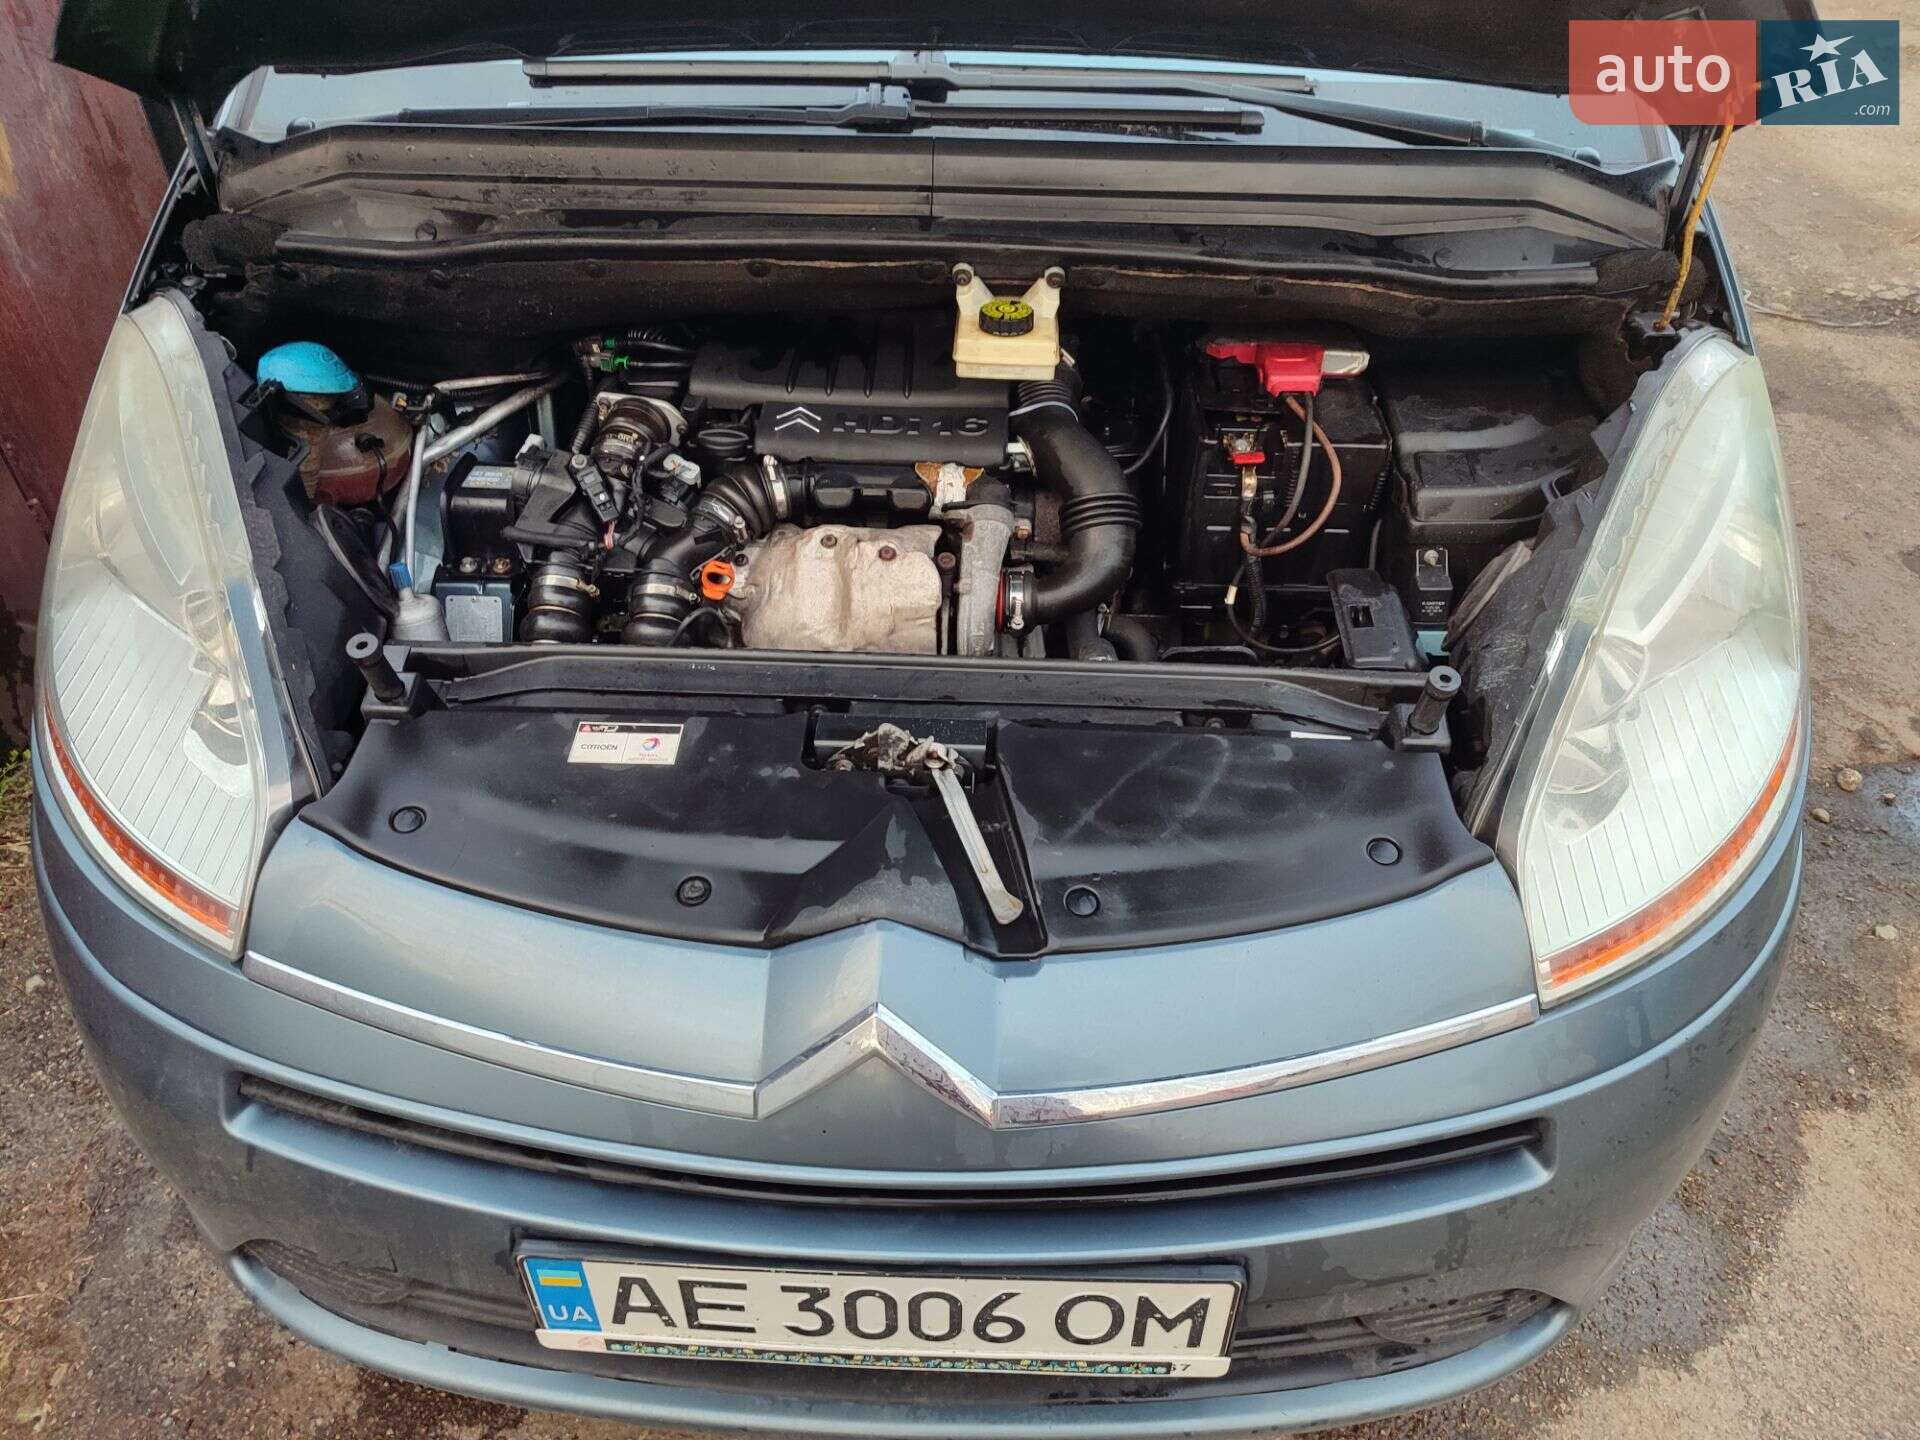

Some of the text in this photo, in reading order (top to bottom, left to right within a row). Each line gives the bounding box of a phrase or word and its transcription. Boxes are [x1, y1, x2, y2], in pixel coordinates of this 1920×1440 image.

[548, 1304, 593, 1322] UA
[612, 1276, 1211, 1348] AE 3006 OM
